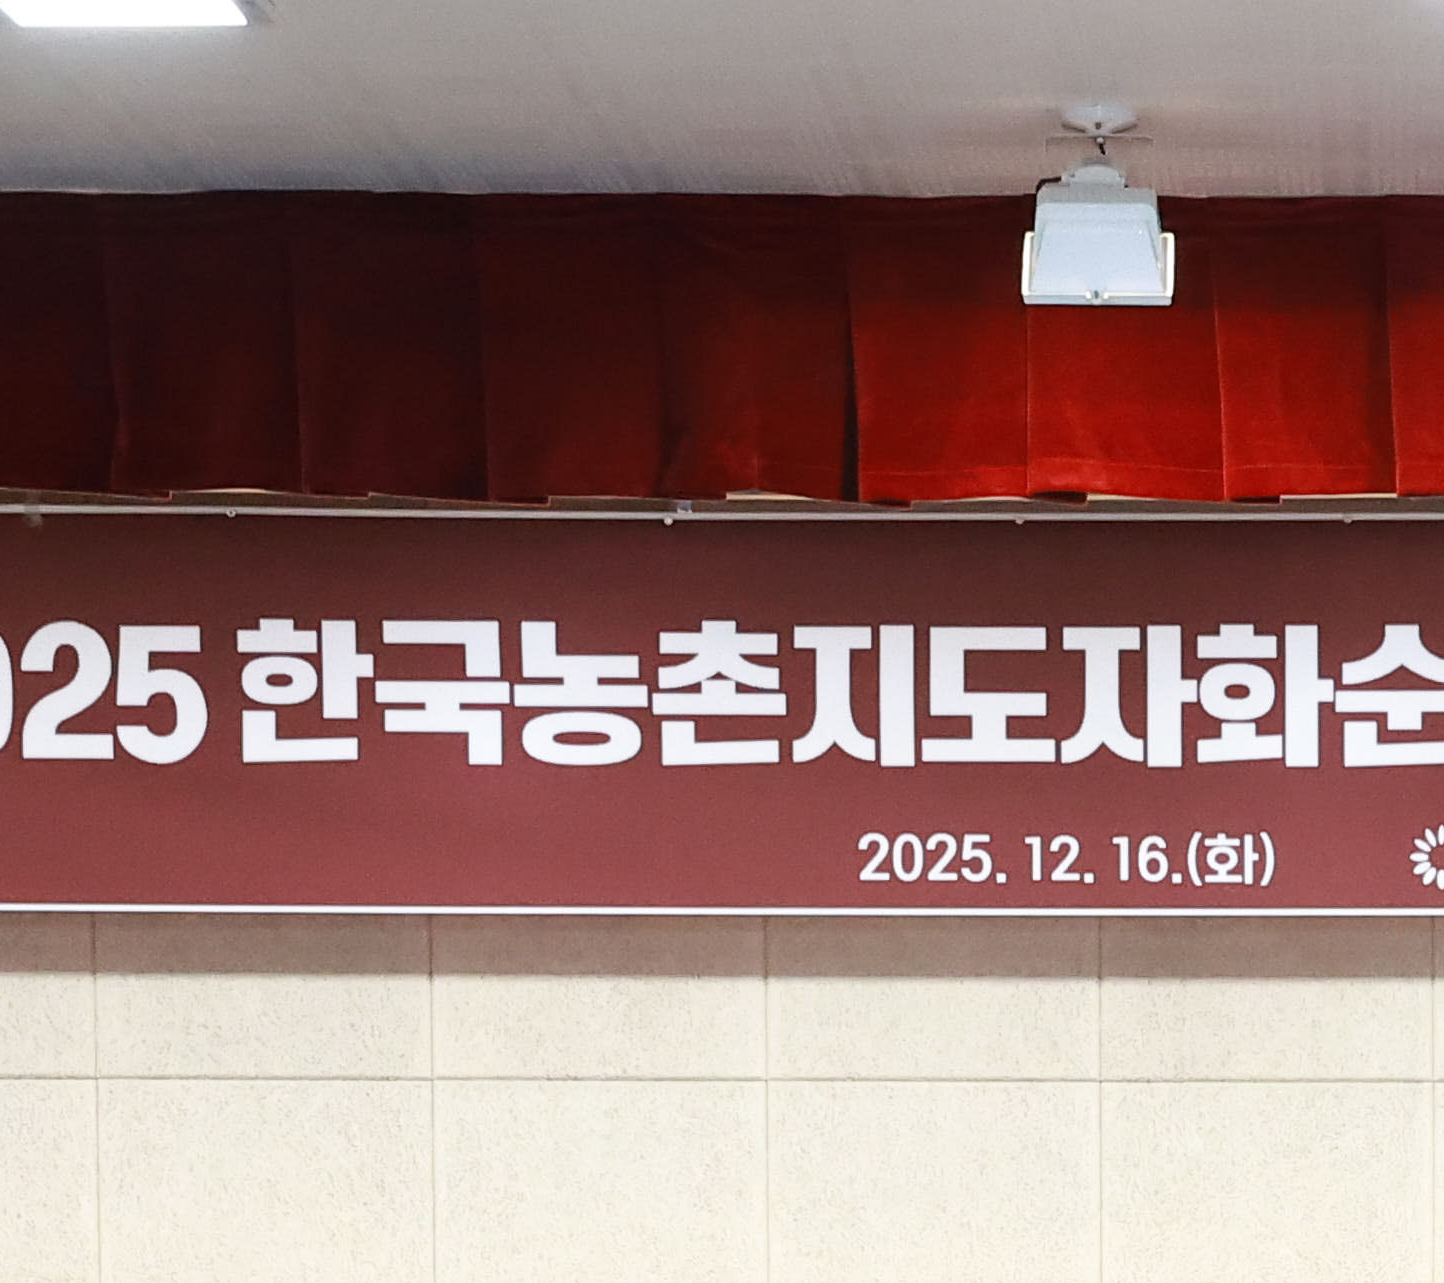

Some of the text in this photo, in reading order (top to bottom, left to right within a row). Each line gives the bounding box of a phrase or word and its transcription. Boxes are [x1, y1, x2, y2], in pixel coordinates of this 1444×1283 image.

[858, 832, 1274, 886] 2025. 12. 16.(화)
